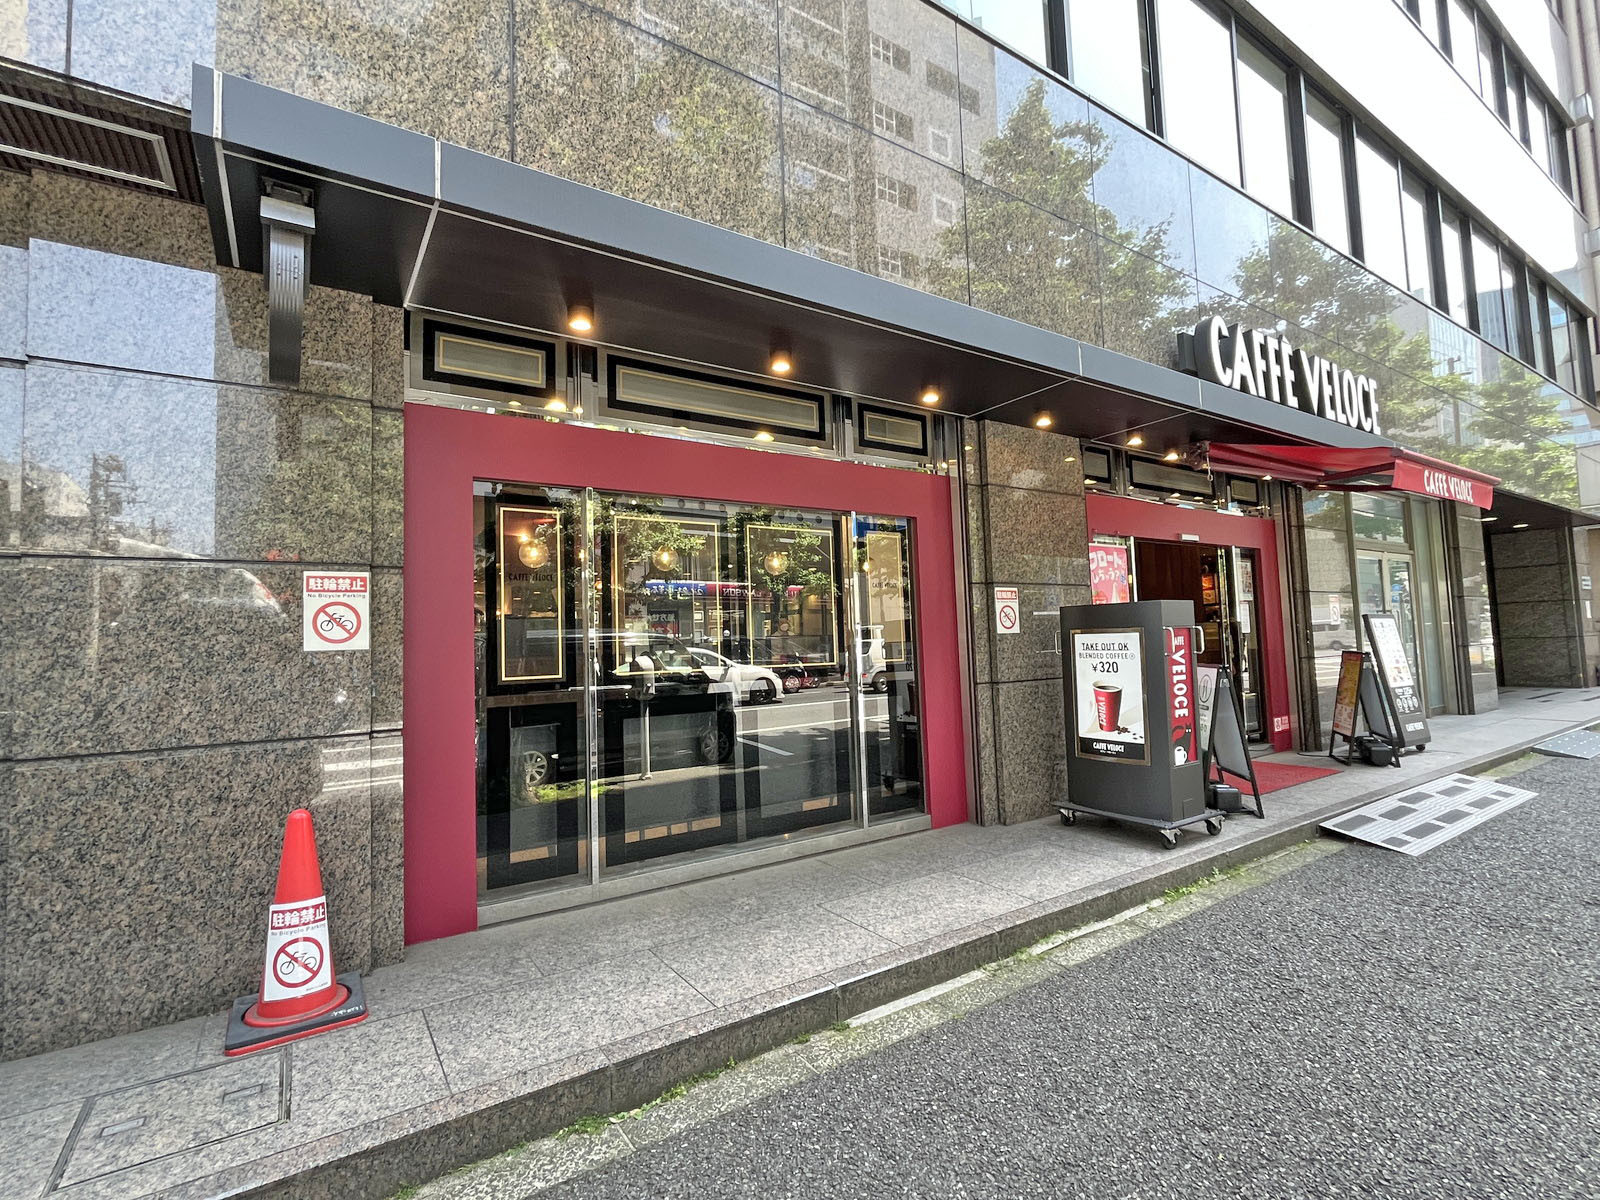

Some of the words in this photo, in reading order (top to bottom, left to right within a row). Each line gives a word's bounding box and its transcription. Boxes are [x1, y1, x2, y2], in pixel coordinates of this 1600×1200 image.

[1300, 349, 1381, 435] VELOCE
[1448, 476, 1473, 503] VELOCE
[308, 577, 366, 591] 駐輪禁止
[1081, 643, 1099, 651] TAKE
[1101, 643, 1116, 651] OUT
[1118, 643, 1129, 651] OK
[1105, 652, 1129, 660] COFFEE
[1091, 661, 1119, 673] ¥320
[1172, 648, 1189, 718] VELOCE
[273, 906, 325, 928] 駐輪禁止
[279, 928, 304, 936] Bicycle
